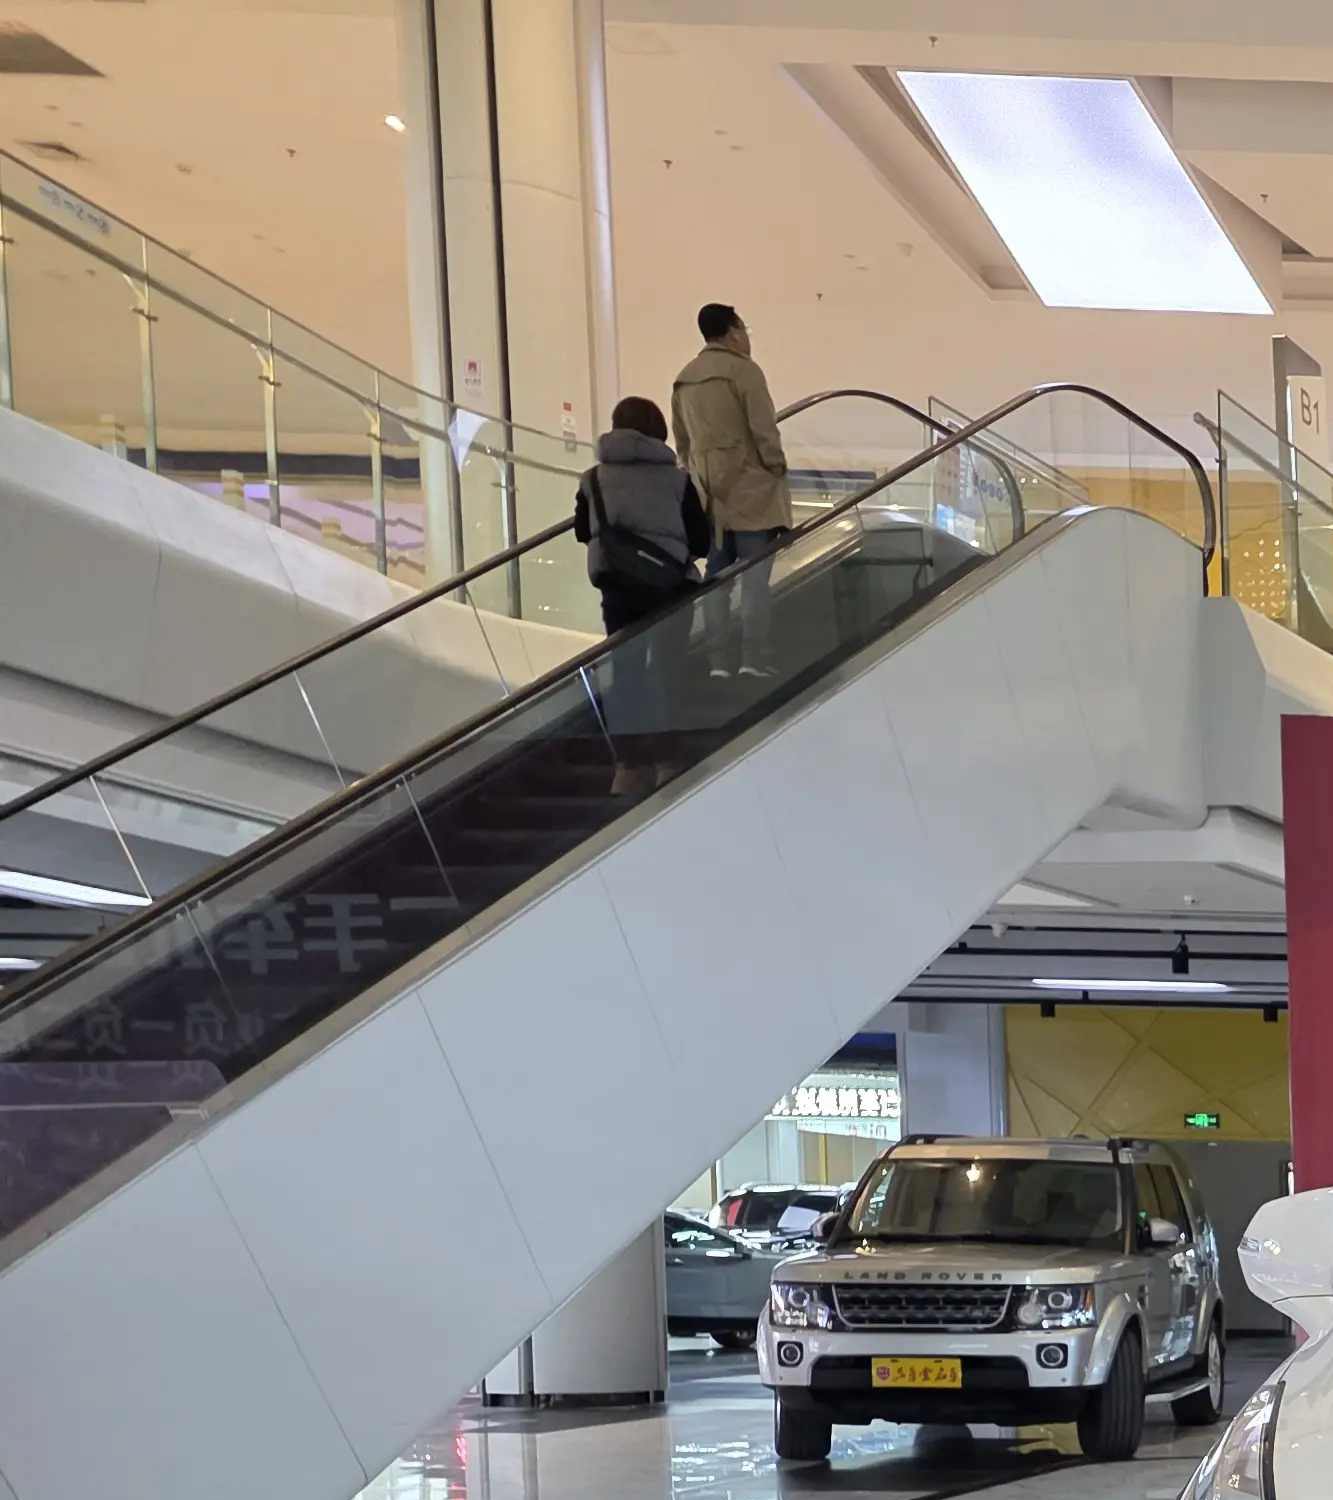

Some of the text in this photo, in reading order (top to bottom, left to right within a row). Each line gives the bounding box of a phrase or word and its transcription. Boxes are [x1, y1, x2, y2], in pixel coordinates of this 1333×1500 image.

[1300, 387, 1320, 435] B1
[843, 1271, 1003, 1281] LAND ROVER
